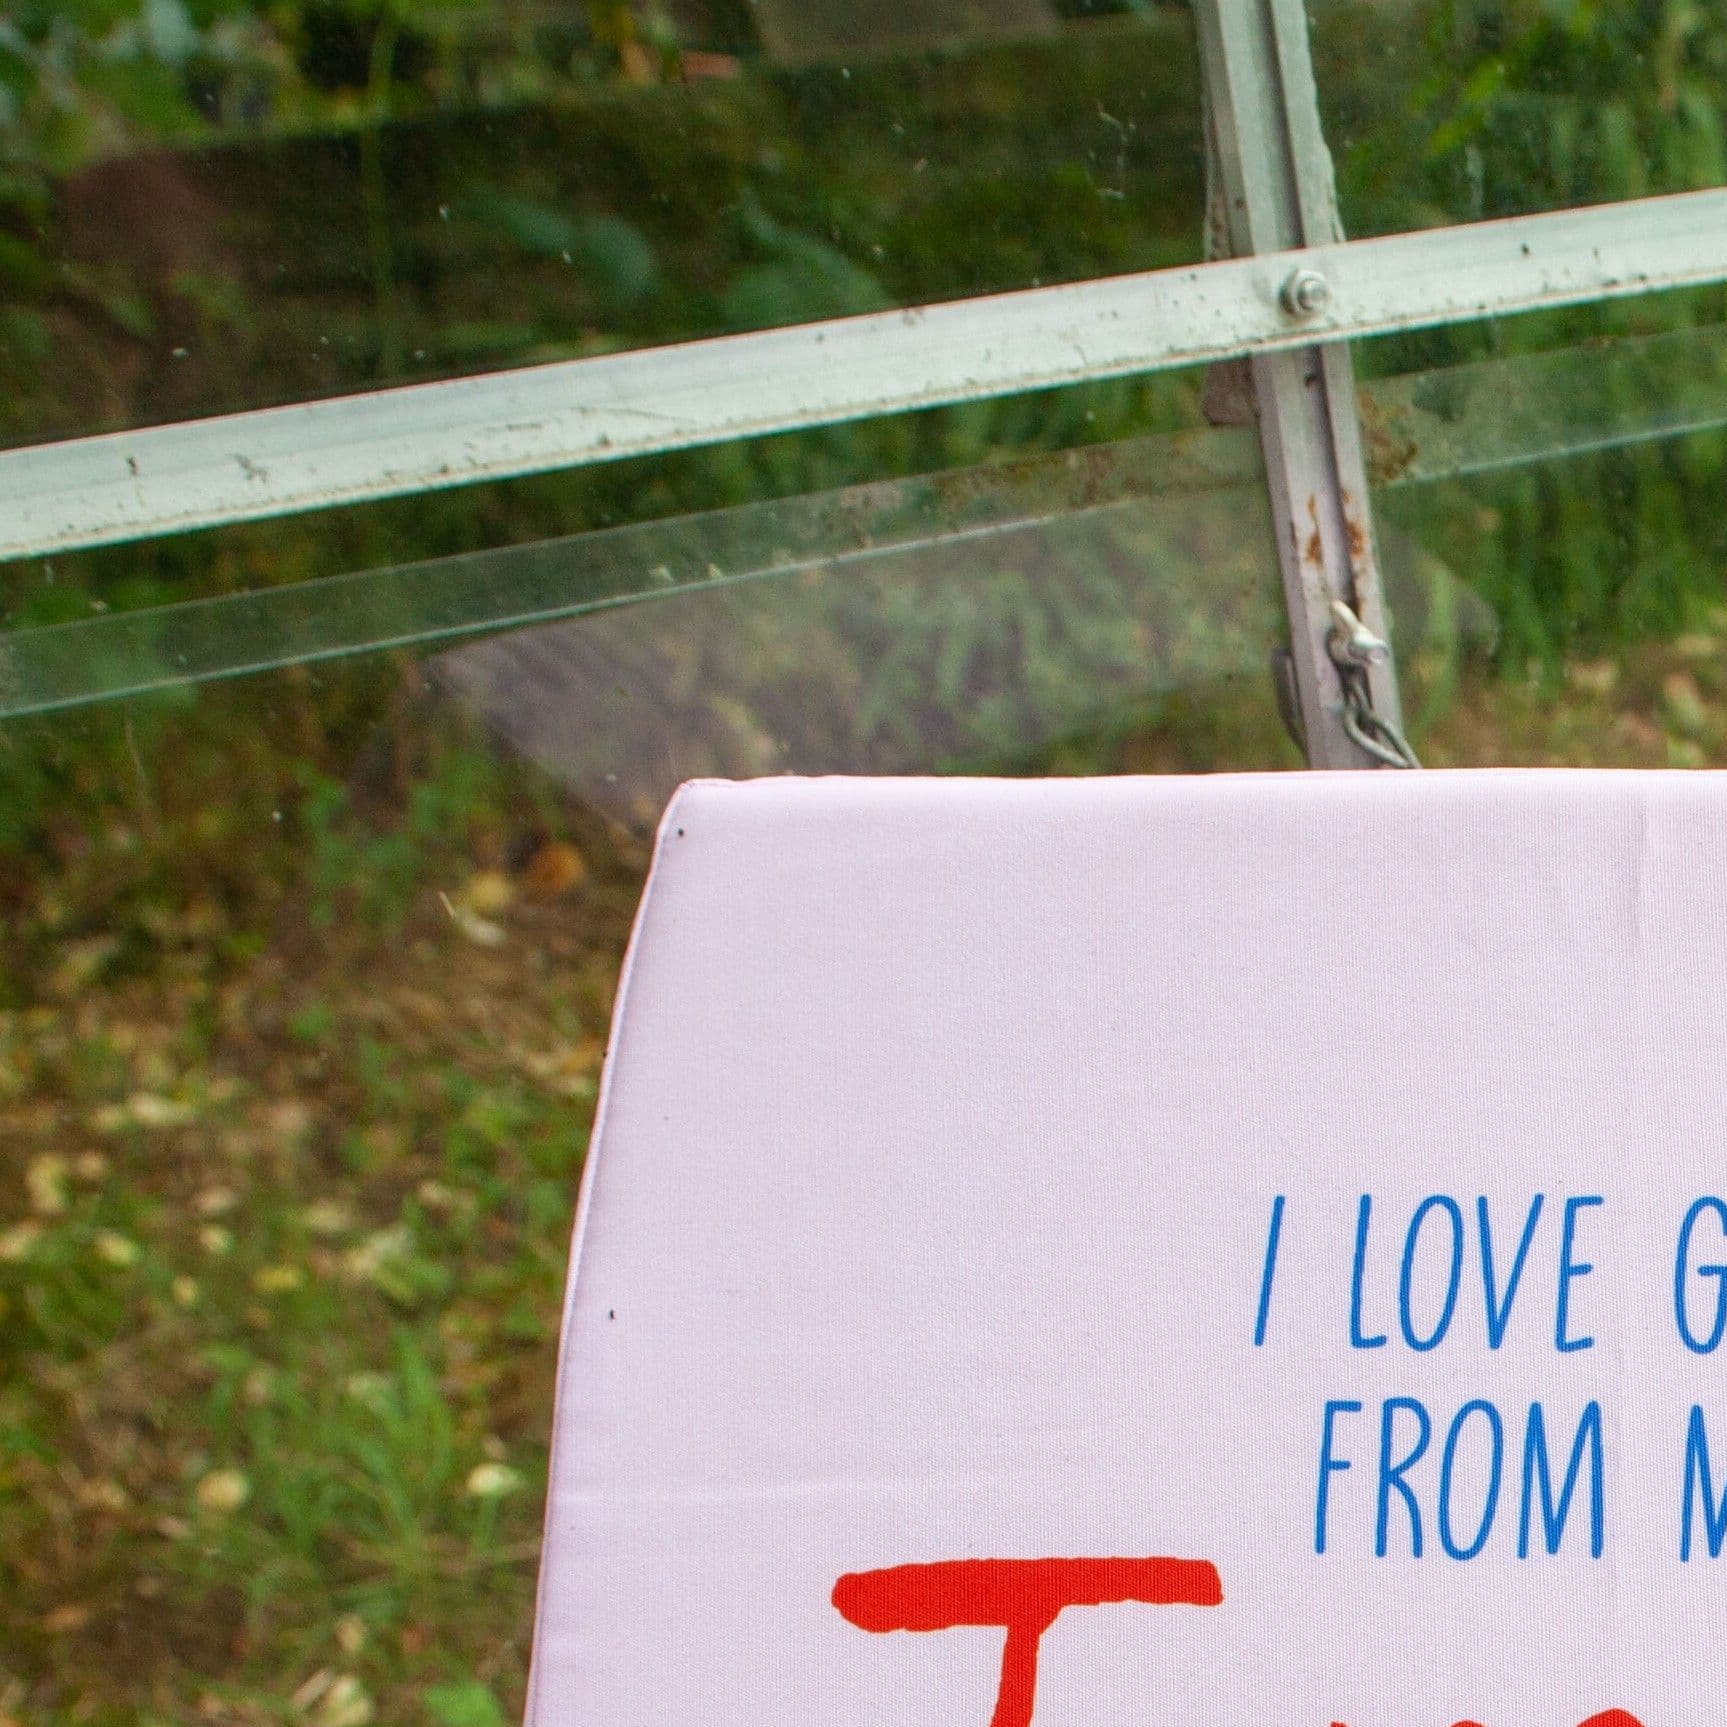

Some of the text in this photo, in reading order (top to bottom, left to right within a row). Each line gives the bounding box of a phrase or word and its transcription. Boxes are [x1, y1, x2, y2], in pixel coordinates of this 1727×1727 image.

[1253, 1194, 1286, 1346] I
[1348, 1192, 1604, 1353] LOVE
[1313, 1397, 1605, 1562] FROM
